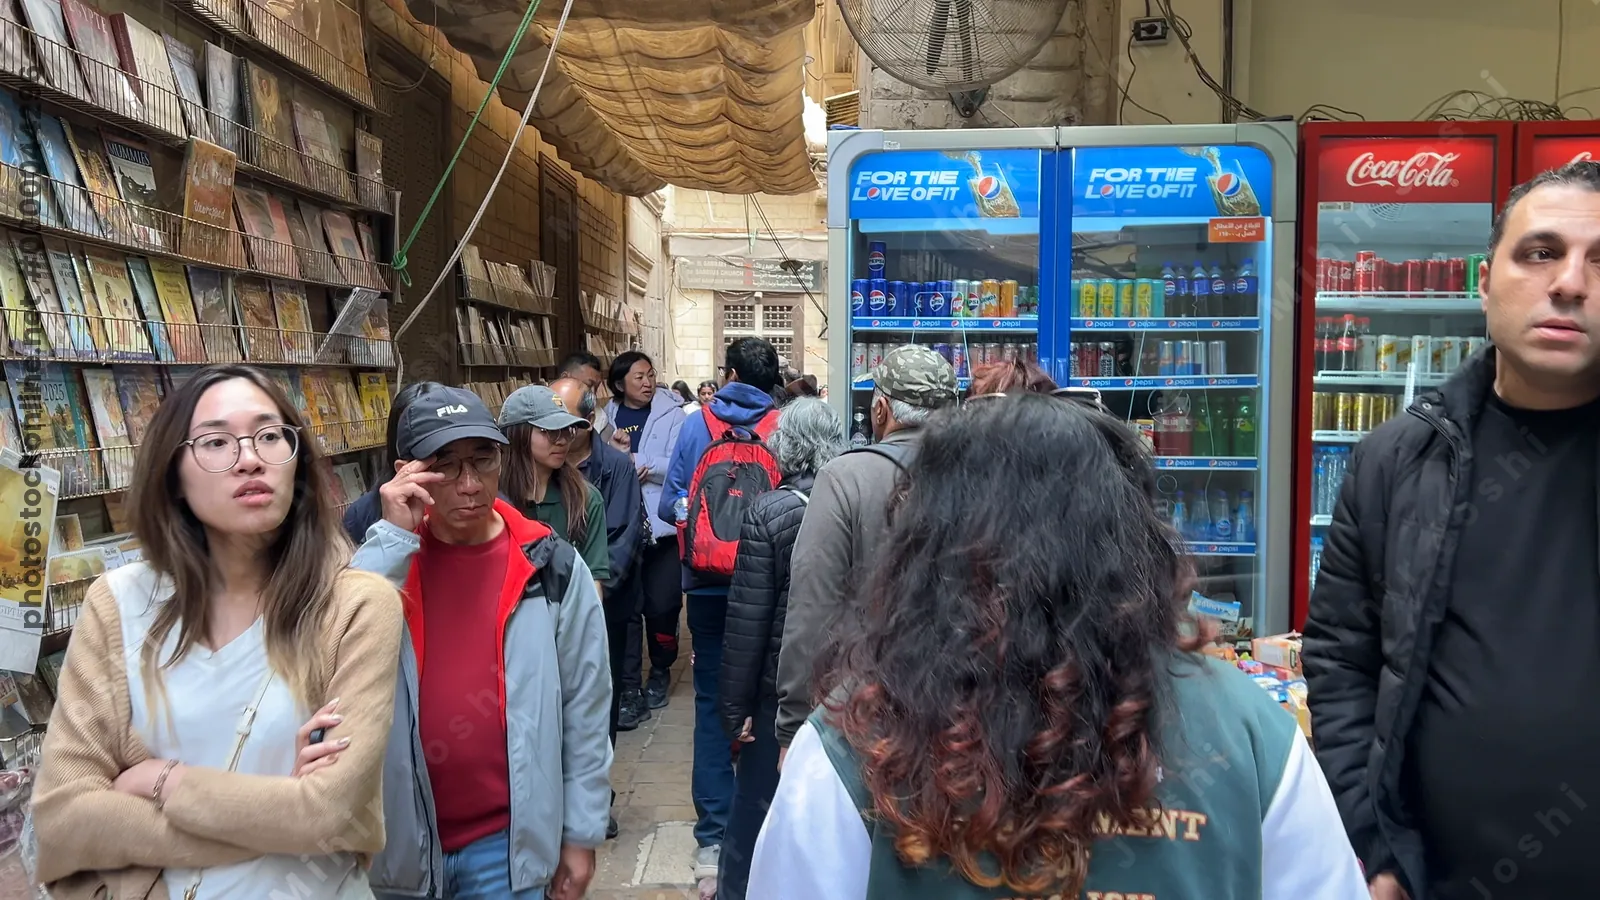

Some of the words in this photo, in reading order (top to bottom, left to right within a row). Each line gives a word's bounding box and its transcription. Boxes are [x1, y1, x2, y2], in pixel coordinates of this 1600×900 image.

[109, 142, 151, 167] MUMMIES
[1089, 168, 1141, 183] FOR
[1144, 168, 1197, 182] THE
[1346, 151, 1462, 188] Coca-Cola
[856, 171, 906, 185] FOR
[909, 171, 959, 185] THE
[881, 320, 900, 328] pepsi
[921, 320, 941, 328] pepsi
[1002, 320, 1021, 328] pepsi
[1094, 320, 1114, 328] pepsi
[1091, 379, 1111, 387] pepsi
[43, 383, 65, 401] 2025
[436, 404, 468, 418] FILA
